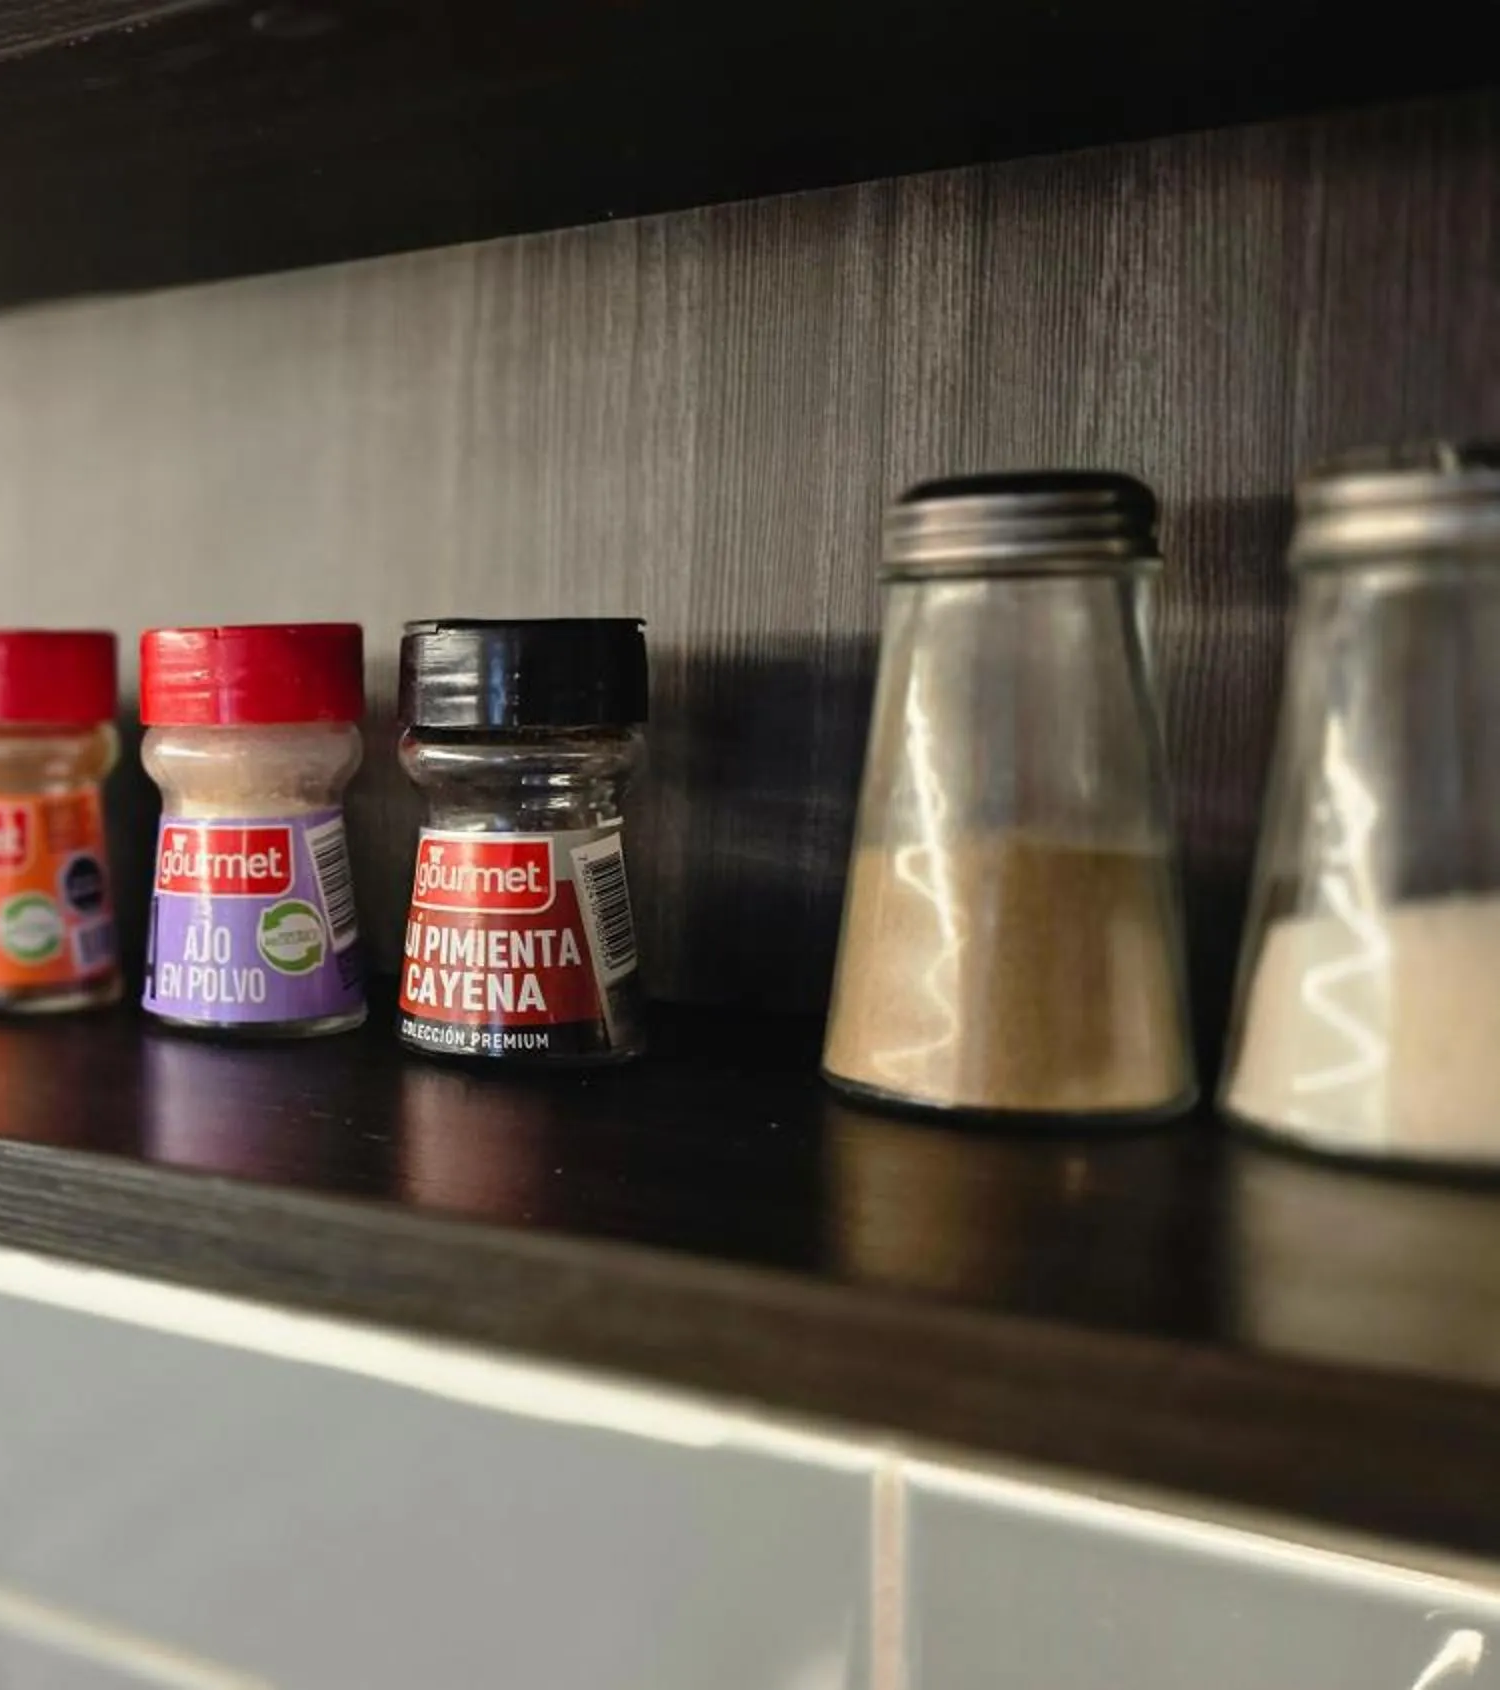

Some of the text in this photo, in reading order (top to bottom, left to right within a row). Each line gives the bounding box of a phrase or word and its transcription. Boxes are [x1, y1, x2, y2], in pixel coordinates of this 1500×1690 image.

[161, 847, 284, 884] gourmet
[417, 860, 543, 896] gourmet
[183, 920, 231, 964] AJO
[423, 925, 582, 969] PIMIENTA
[160, 962, 266, 1004] EN POLVO
[405, 963, 548, 1013] CAYENA
[401, 1018, 550, 1050] COLECCIÓN PREMIUM
